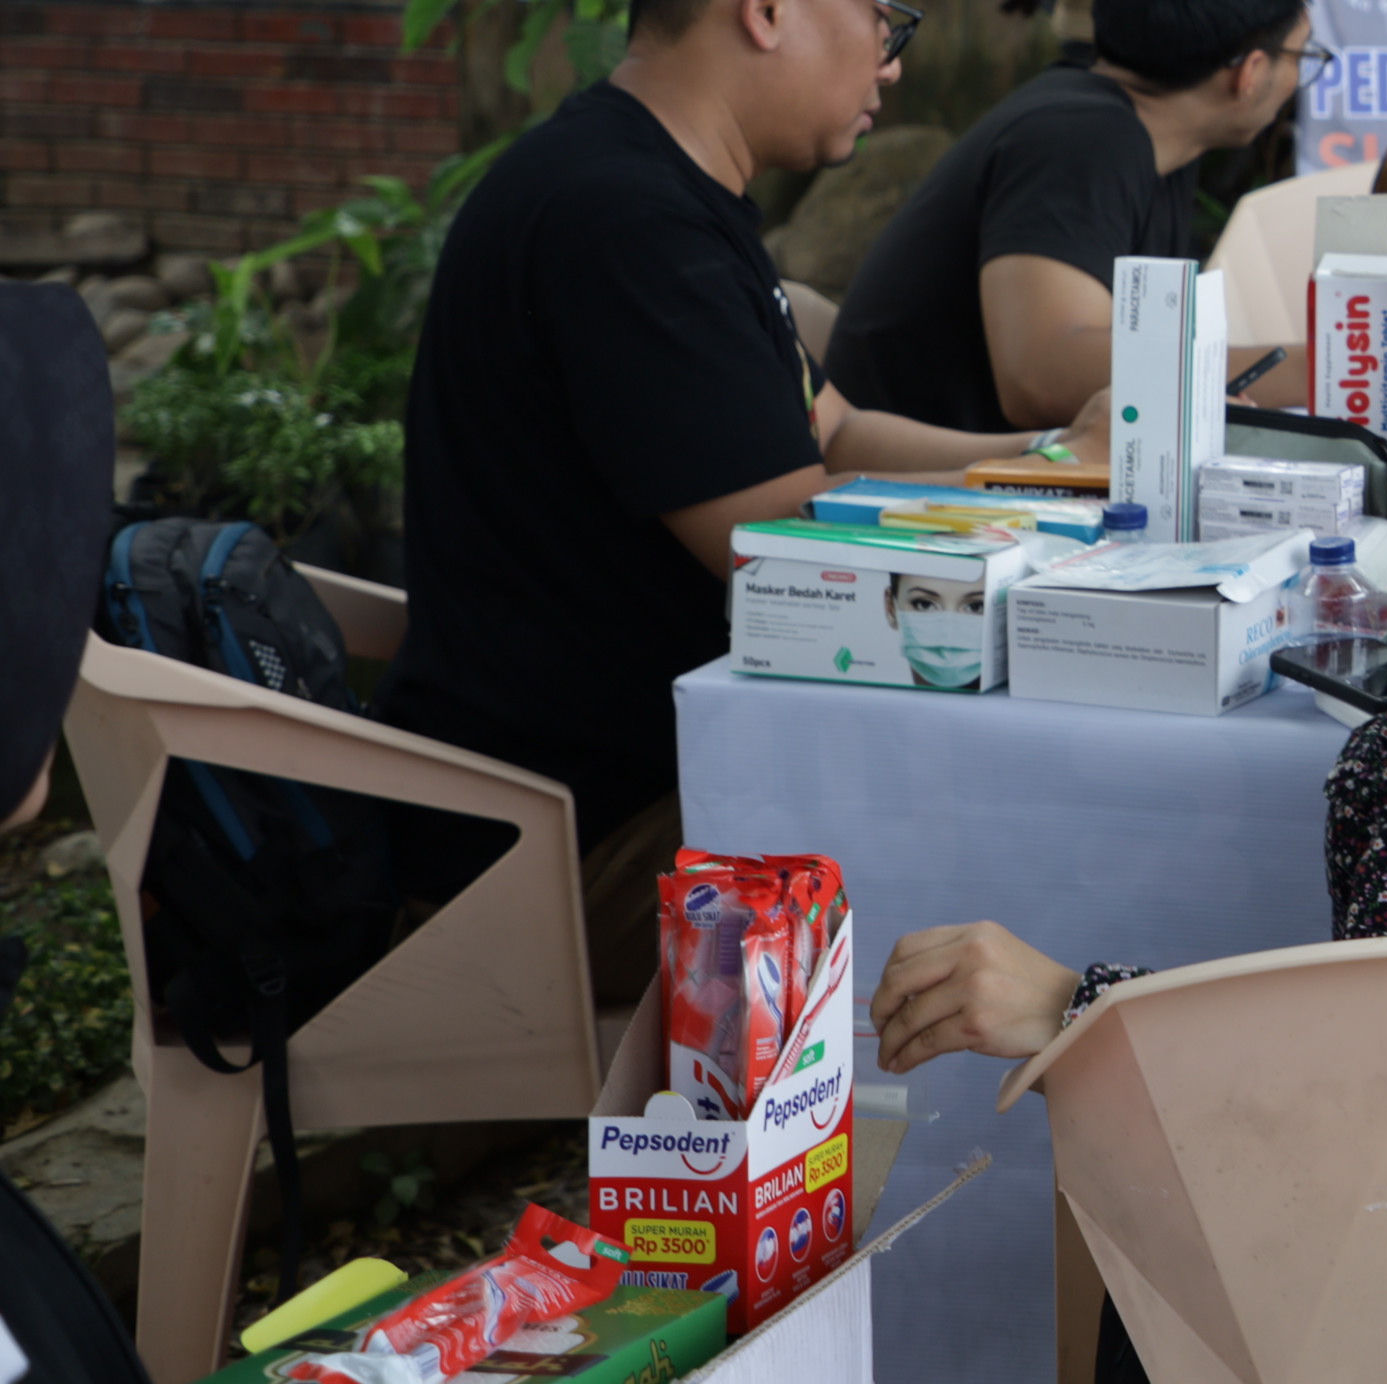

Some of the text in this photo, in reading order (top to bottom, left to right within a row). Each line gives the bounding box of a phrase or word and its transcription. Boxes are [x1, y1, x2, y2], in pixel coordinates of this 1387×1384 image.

[1129, 264, 1142, 332] PARACETAMOL
[1335, 296, 1378, 427] iolysin
[1124, 438, 1136, 504] ACETAMOL
[745, 582, 857, 602] Masker Bedah Karet
[742, 656, 771, 668] 50pcs
[763, 1066, 842, 1131] Pepsodent
[601, 1126, 730, 1155] Pepsodent
[755, 1162, 803, 1210] BRILIAN
[599, 1187, 738, 1215] BRILIAN
[631, 1224, 706, 1237] SUPER MURAH
[602, 1243, 623, 1261] soft
[634, 1236, 657, 1255] Rp
[649, 1271, 688, 1290] SIKAT
